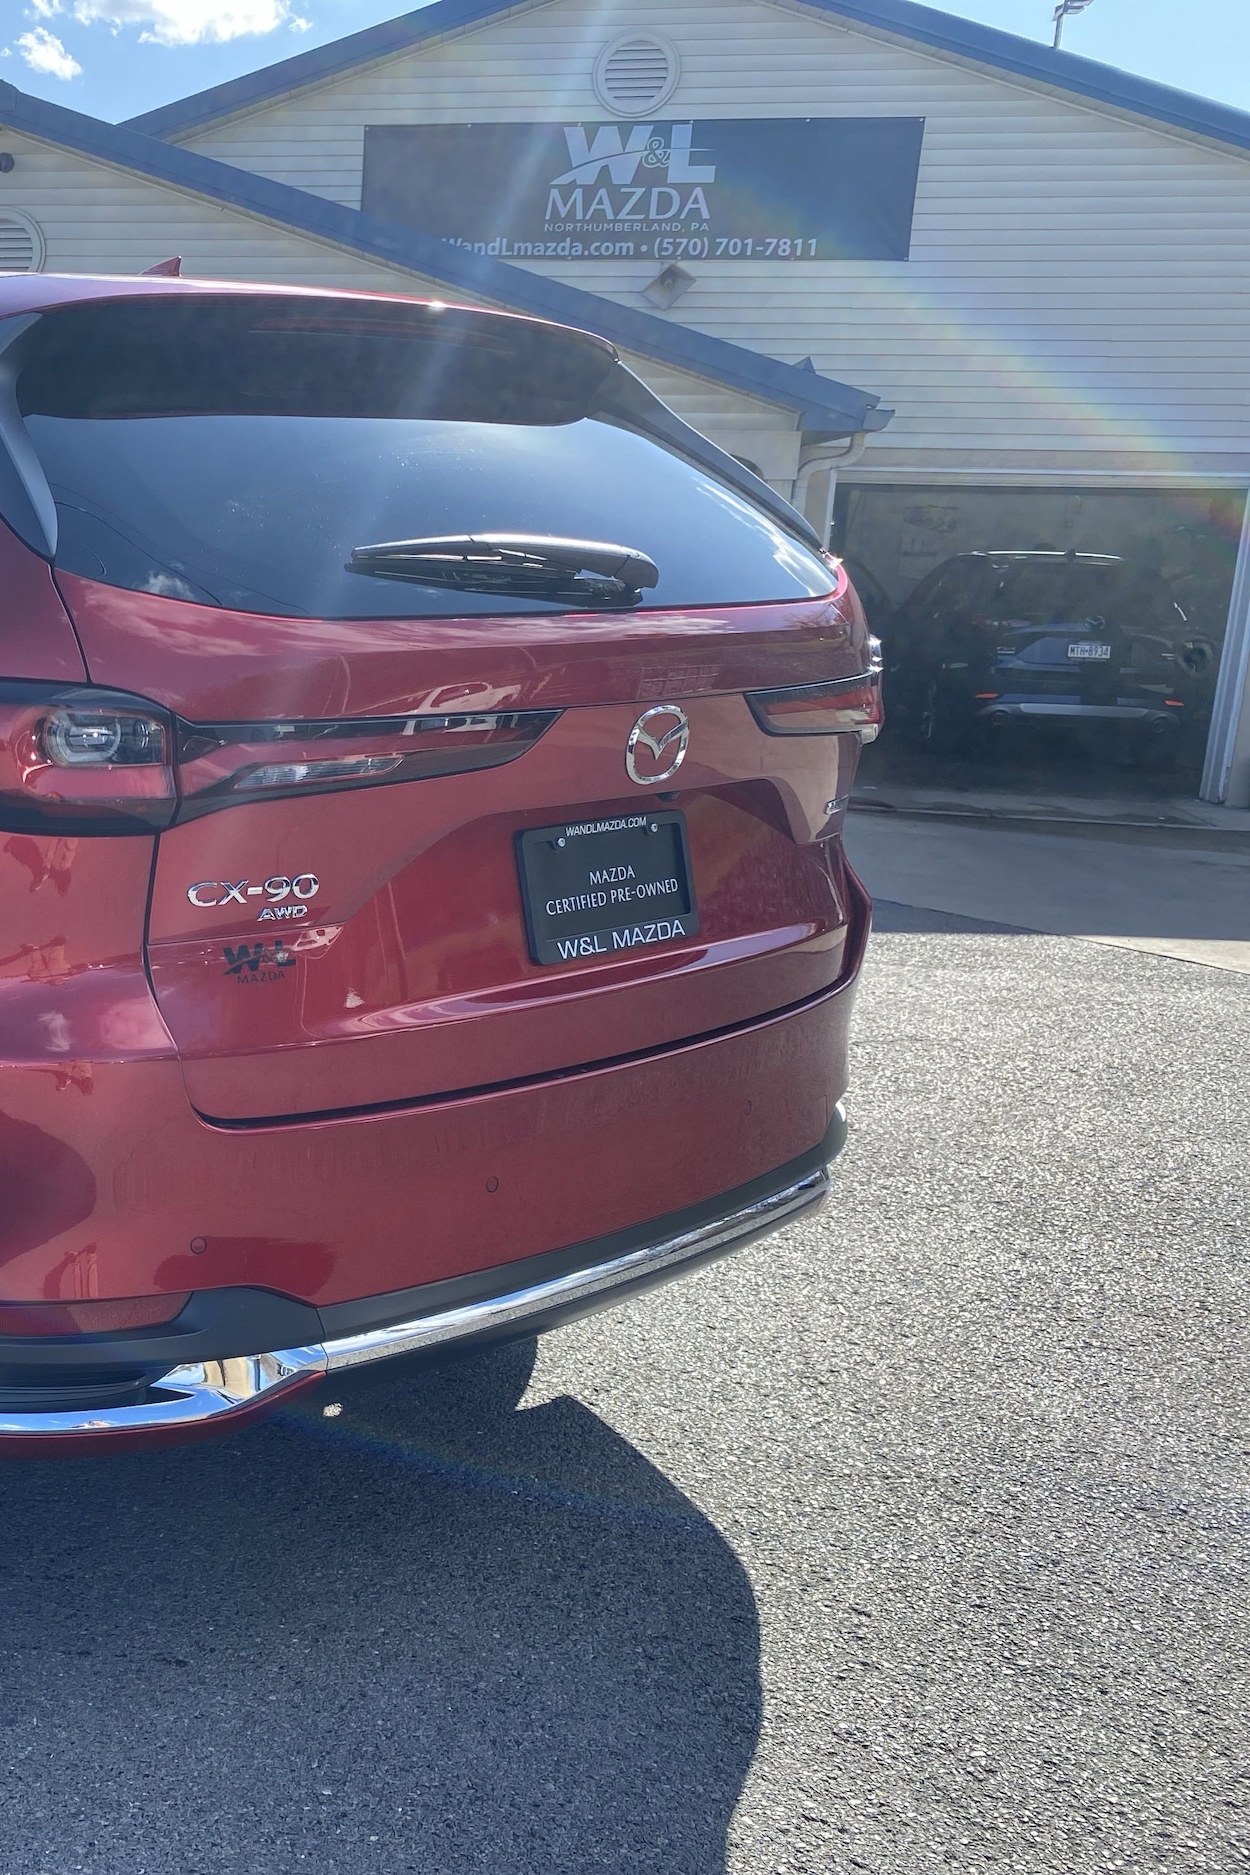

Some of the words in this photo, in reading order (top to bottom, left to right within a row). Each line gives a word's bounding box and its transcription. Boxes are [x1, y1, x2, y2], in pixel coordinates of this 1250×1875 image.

[550, 124, 716, 185] W&L
[545, 187, 710, 220] MAZDA
[544, 222, 686, 233] NORTHUMBERLAND,
[690, 222, 710, 232] PA
[653, 237, 709, 259] (570)
[715, 238, 818, 257] 701-7811
[565, 816, 647, 837] WANDLMAZDA.COM
[588, 865, 636, 886] MAZDA
[187, 873, 320, 907] CX-90
[546, 892, 607, 916] CERTIFIED
[611, 878, 679, 904] PRE-OWNED
[257, 904, 308, 922] AWD
[557, 937, 607, 960] W&L
[612, 919, 686, 950] MAZDA
[237, 970, 287, 985] MAZDA
